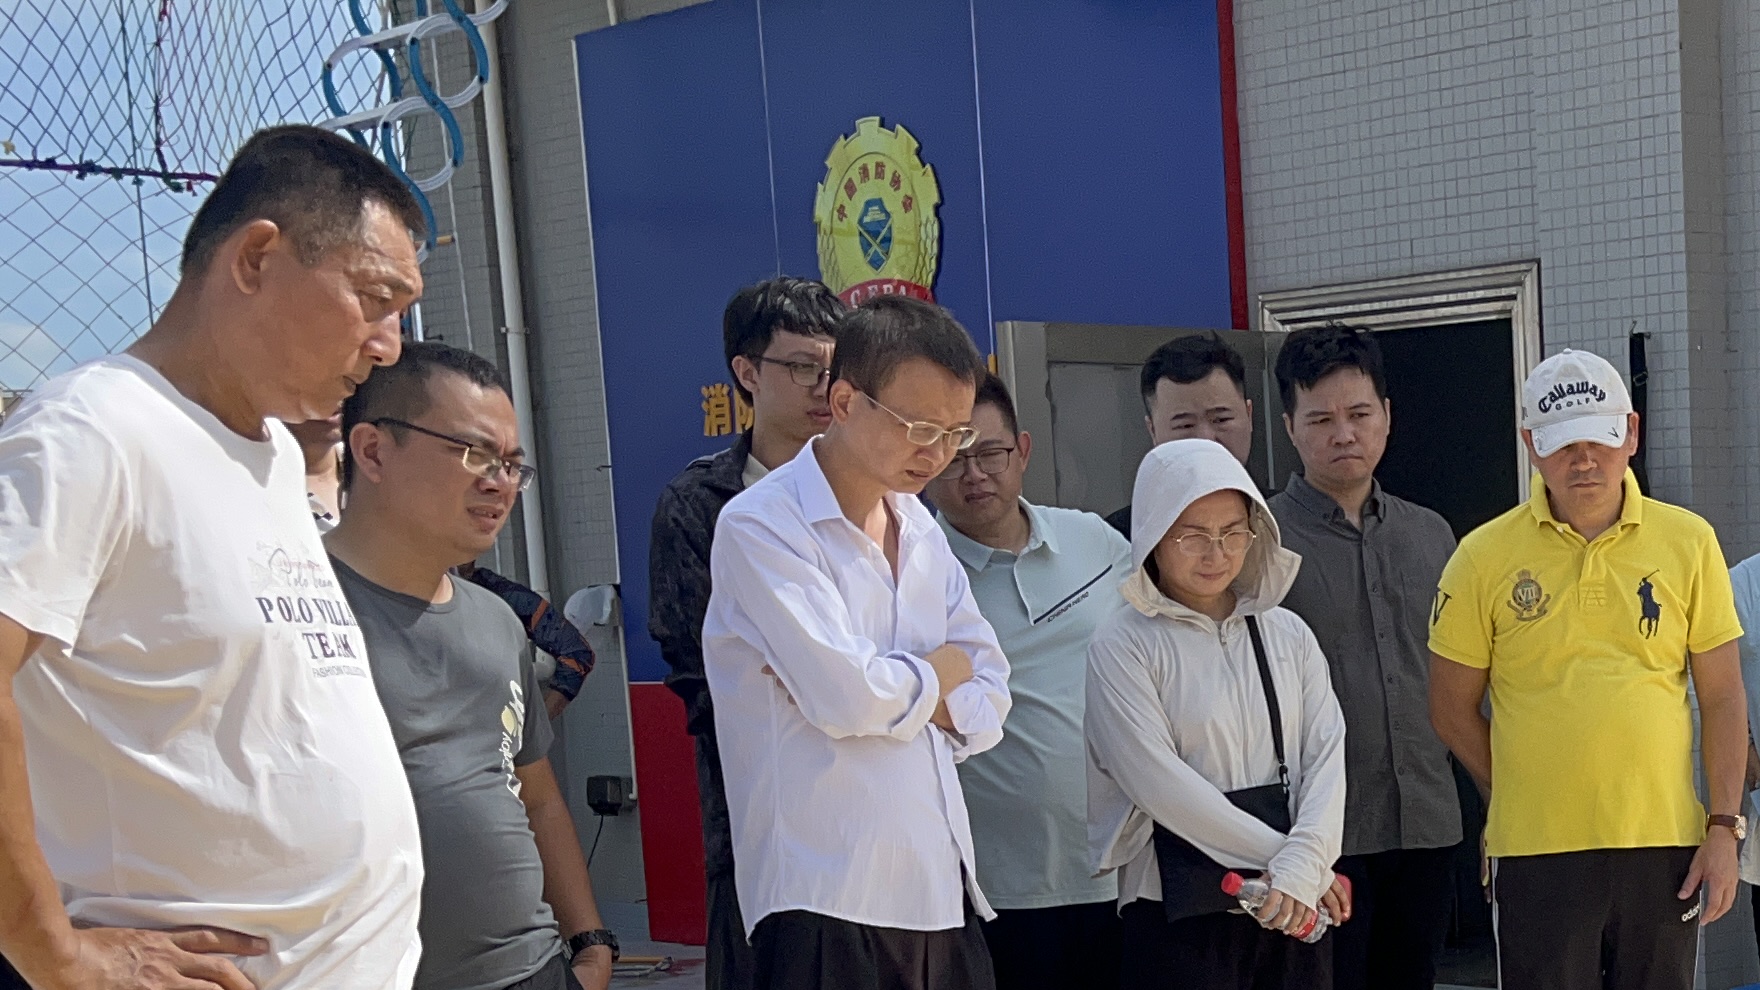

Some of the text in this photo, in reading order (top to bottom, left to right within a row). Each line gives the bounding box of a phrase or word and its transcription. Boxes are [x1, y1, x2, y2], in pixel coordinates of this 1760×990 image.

[1538, 381, 1606, 413] Callaway
[1555, 397, 1590, 411] GOLF
[255, 596, 313, 624] POLO
[302, 631, 357, 660] TEAM
